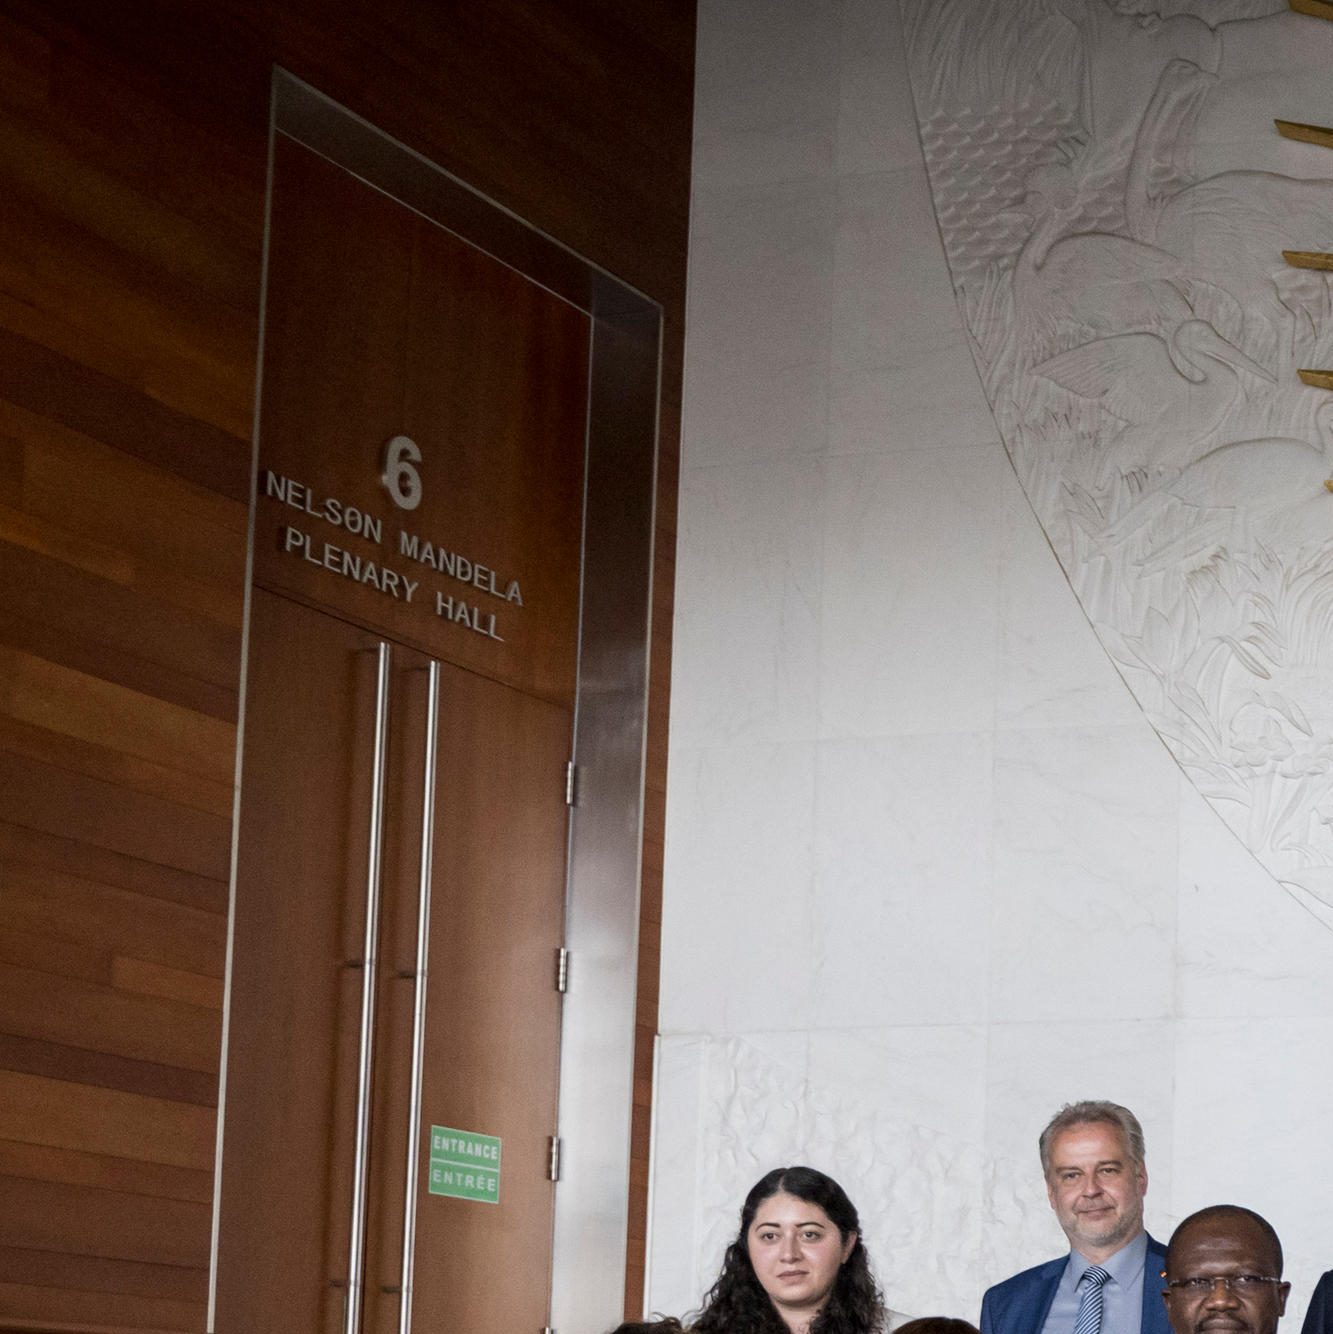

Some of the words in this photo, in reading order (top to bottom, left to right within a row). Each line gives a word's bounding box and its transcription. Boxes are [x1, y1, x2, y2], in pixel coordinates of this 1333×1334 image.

[383, 435, 423, 511] 6
[266, 470, 383, 544] NELSON
[400, 529, 524, 607] MANDELA
[285, 526, 419, 603] PLENARY
[436, 591, 505, 643] HALL
[432, 1168, 497, 1193] ENTRÉE
[433, 1135, 498, 1161] ENTRANCE
